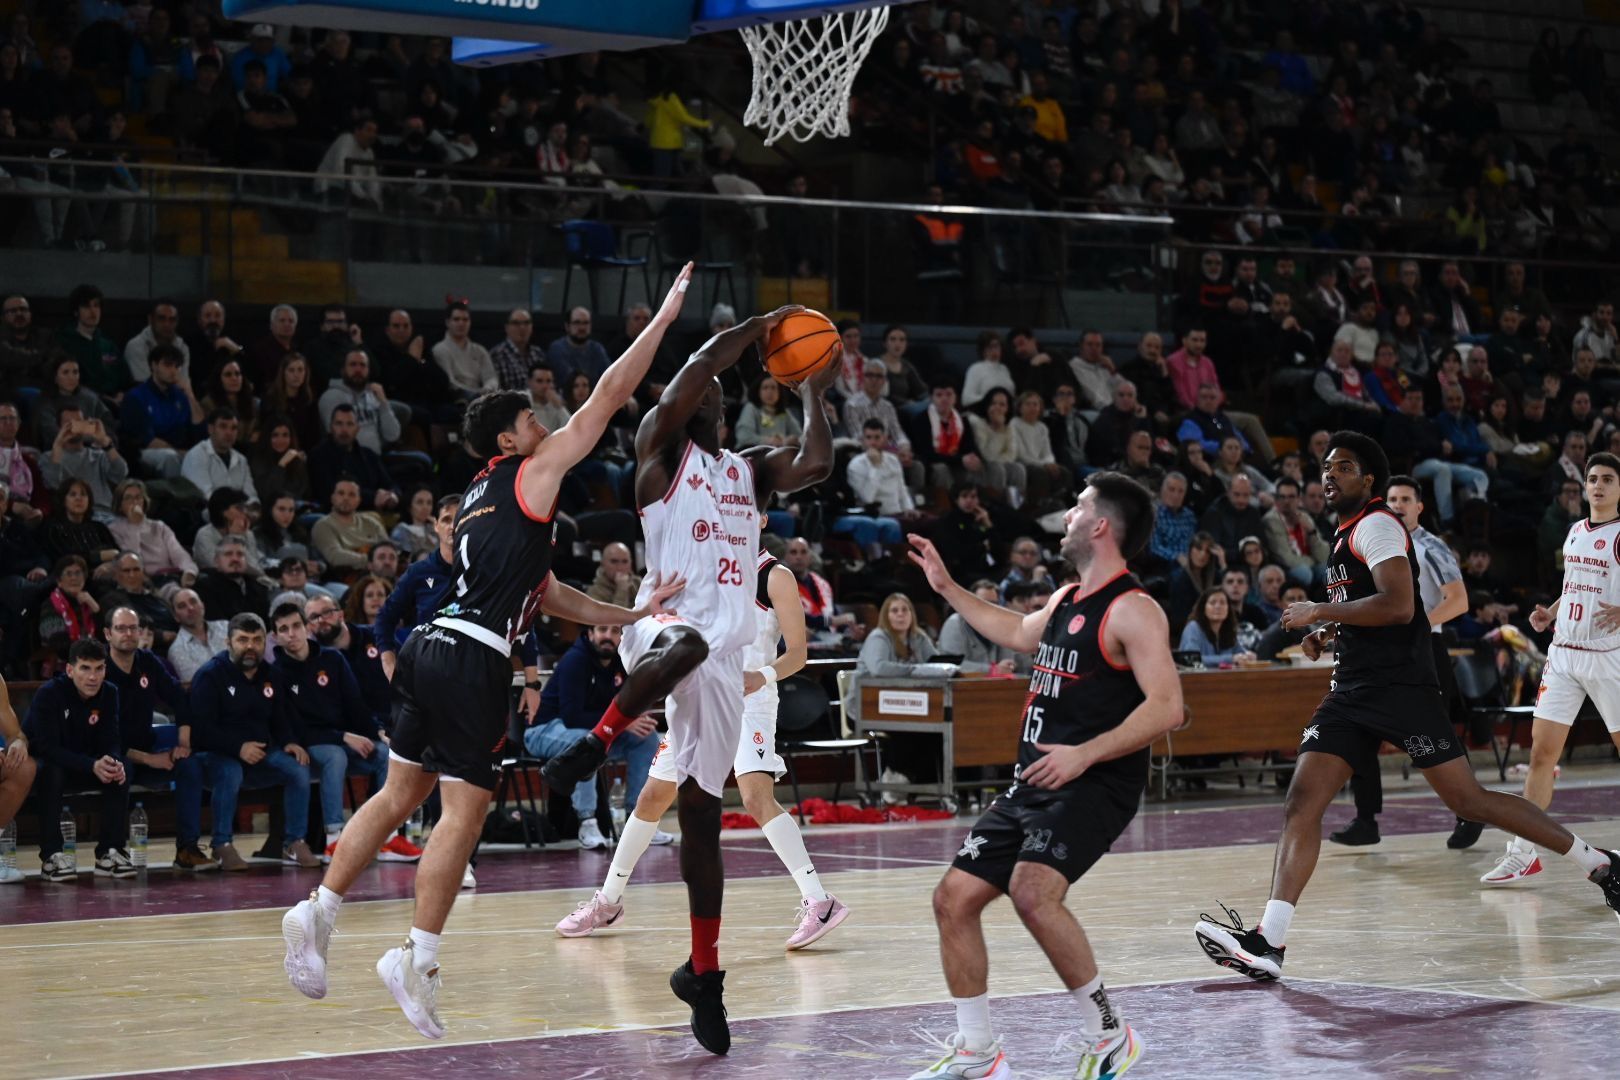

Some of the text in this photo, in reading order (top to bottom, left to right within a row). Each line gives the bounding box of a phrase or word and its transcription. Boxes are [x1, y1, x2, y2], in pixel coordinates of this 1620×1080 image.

[717, 557, 743, 586] 25
[1583, 557, 1609, 568] RURAL
[1568, 602, 1583, 622] 10
[1023, 704, 1044, 743] 15
